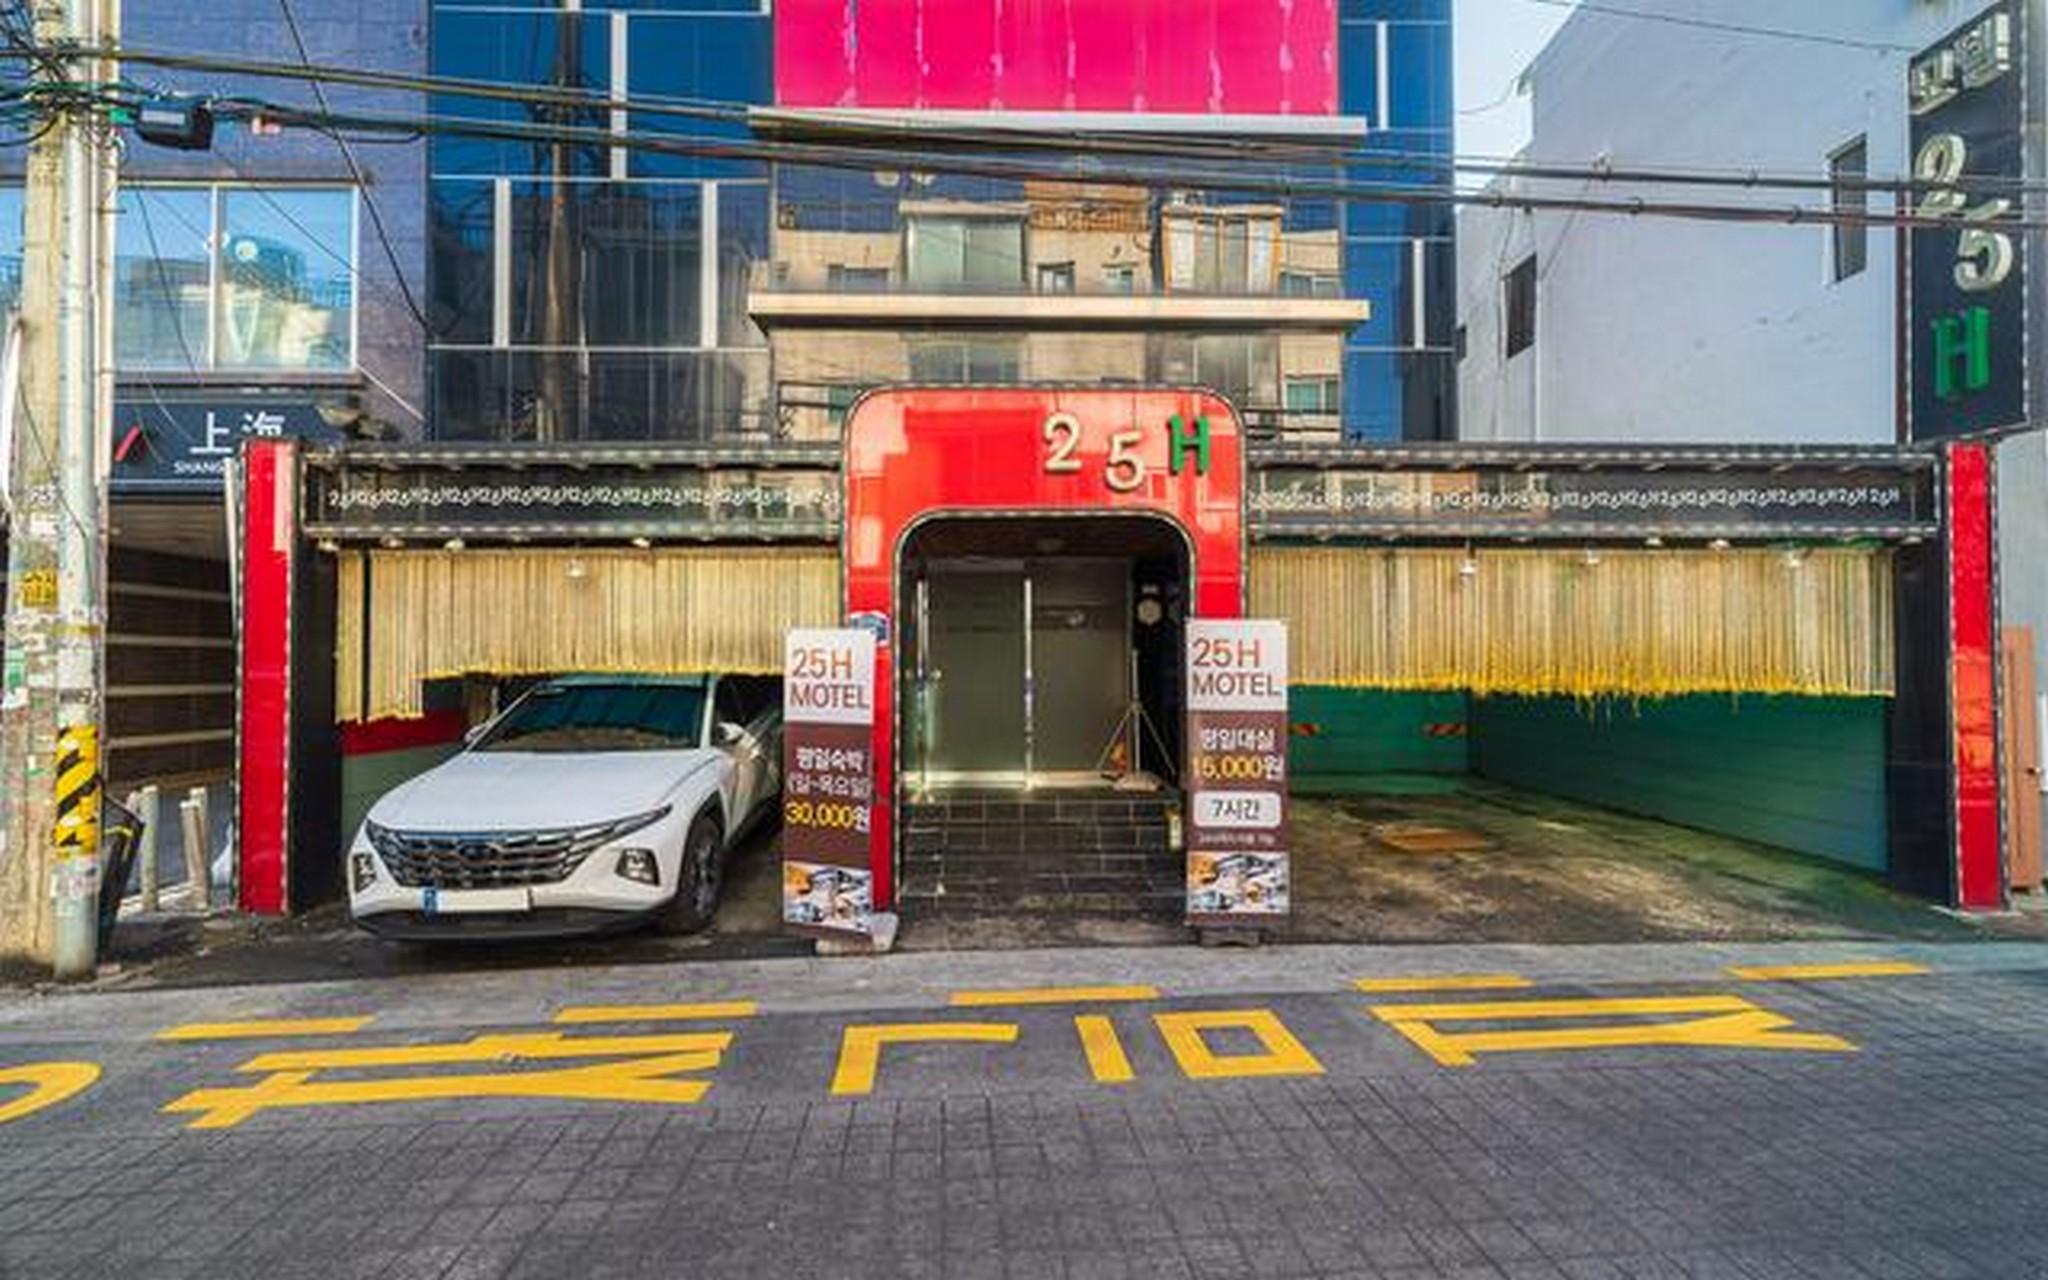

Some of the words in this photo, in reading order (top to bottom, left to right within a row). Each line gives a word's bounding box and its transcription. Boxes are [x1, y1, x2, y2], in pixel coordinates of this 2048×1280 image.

[1044, 413, 1211, 492] 25H
[174, 460, 226, 474] SHANG
[792, 648, 853, 679] 25H
[1193, 638, 1260, 668] 25H
[790, 683, 870, 708] MOTEL
[1193, 671, 1283, 696] MOTEL
[785, 802, 870, 833] 30,000원
[1211, 798, 1260, 820] 7시간
